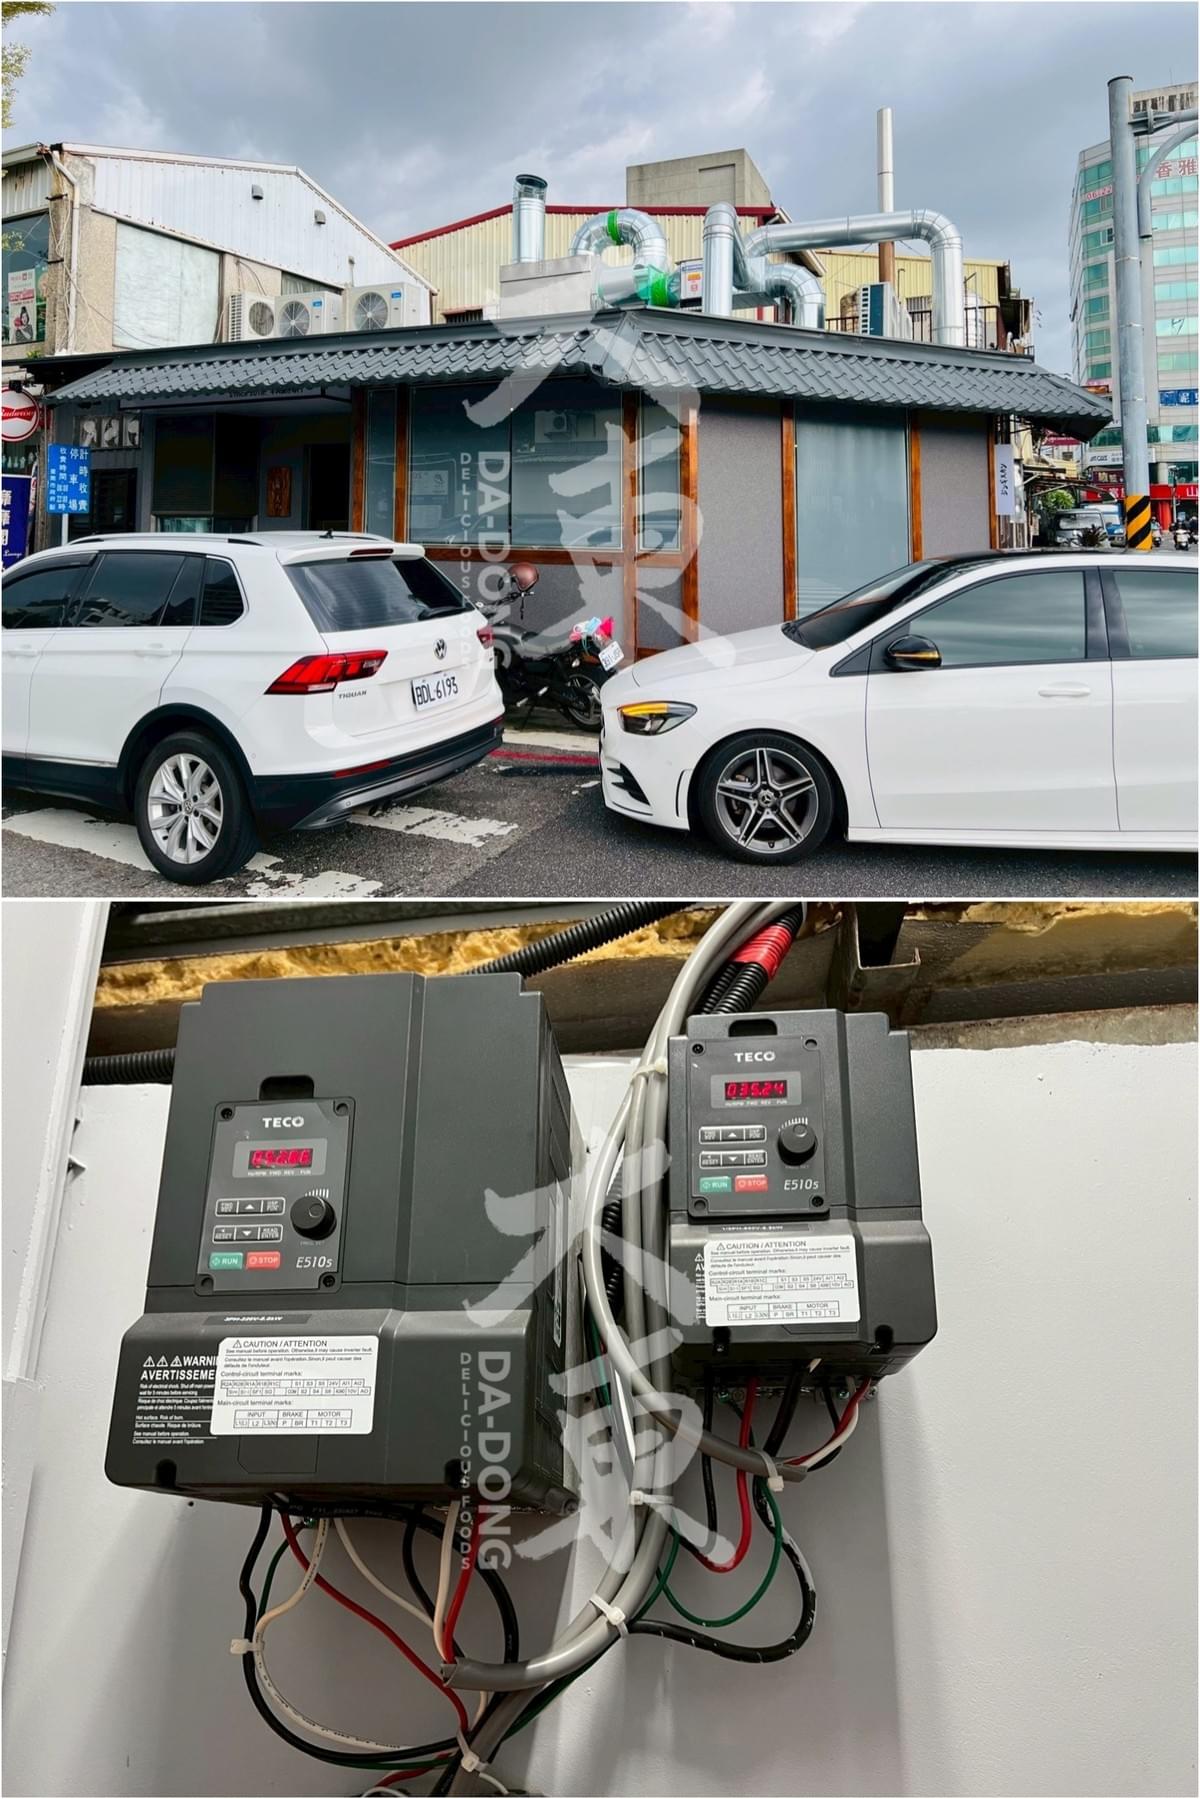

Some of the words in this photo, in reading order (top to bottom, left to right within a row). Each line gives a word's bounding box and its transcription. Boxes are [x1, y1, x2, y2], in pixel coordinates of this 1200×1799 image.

[68, 448, 79, 511] 停車場
[79, 448, 88, 512] 計時收費
[338, 690, 367, 699] TIGUAN
[733, 1051, 776, 1062] TECO
[262, 1116, 305, 1128] TECO
[711, 1181, 728, 1189] RUN
[747, 1179, 768, 1187] STOP
[783, 1178, 819, 1190] E510s
[221, 1257, 239, 1265] RUN
[258, 1255, 279, 1264] STOP
[296, 1256, 333, 1269] E510s
[318, 1410, 342, 1418] MOTOR
